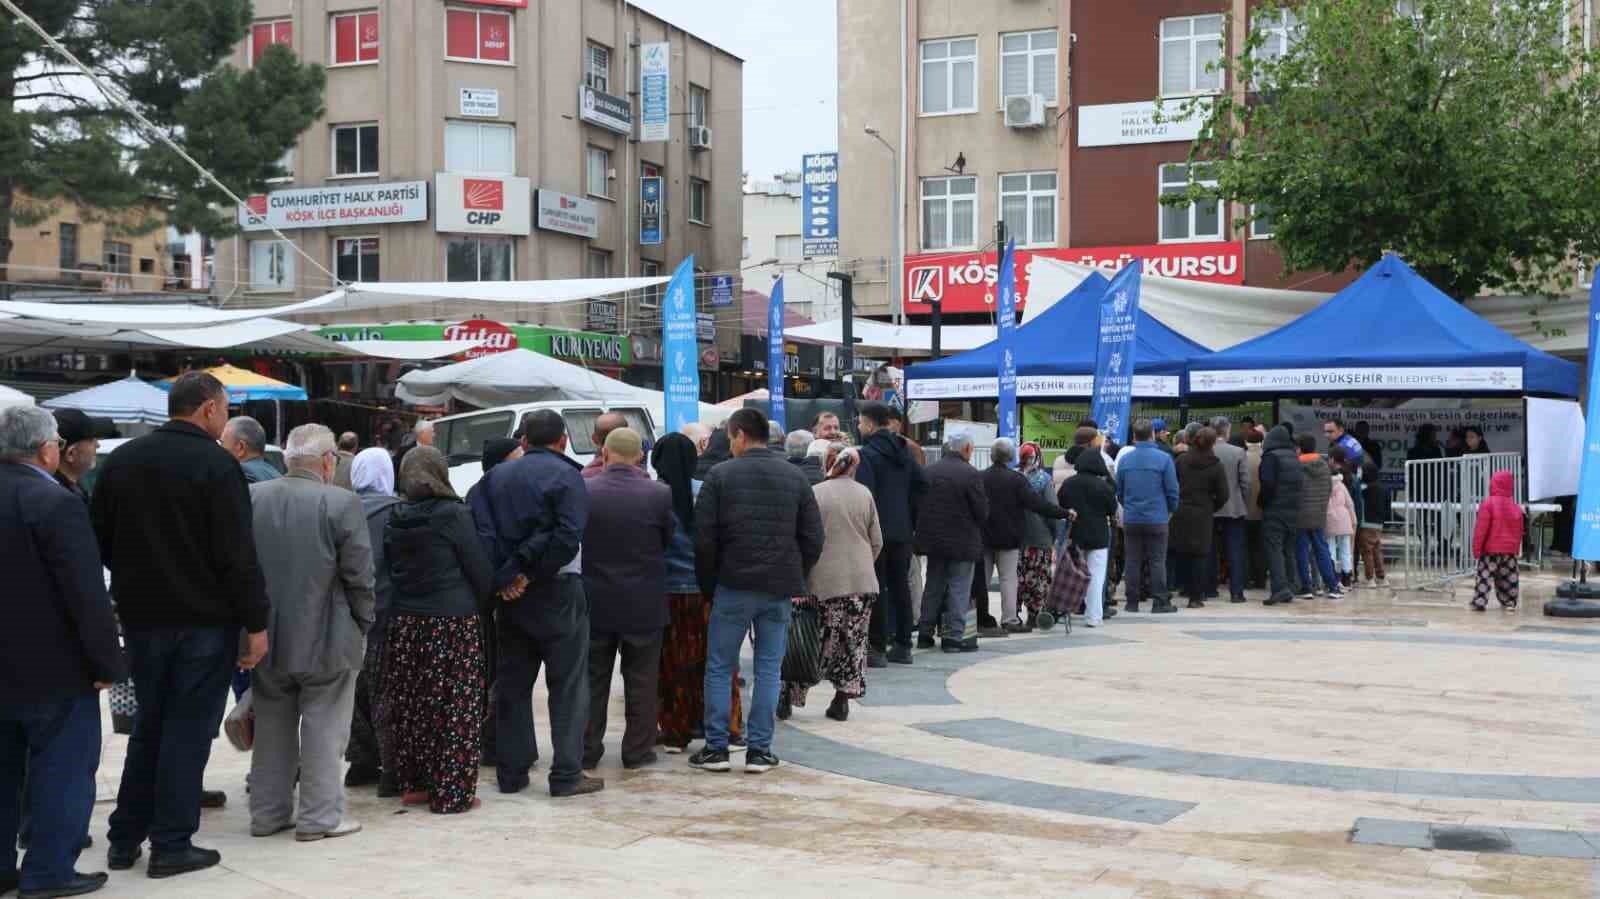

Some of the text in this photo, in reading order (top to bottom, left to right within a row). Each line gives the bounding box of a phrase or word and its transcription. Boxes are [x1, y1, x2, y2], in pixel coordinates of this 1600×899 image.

[1121, 117, 1149, 126] HALK
[271, 184, 420, 209] CUMHURİYET HALK PARTİSİ
[286, 203, 403, 222] KÖŞK İLÇE BAŞKANLIĞI
[466, 211, 500, 225] CHP
[948, 260, 1016, 287] KÖŞ
[1143, 255, 1237, 278] KURSU
[444, 325, 516, 350] Tutar
[1304, 372, 1384, 385] BÜYÜKŞEHİR
[1017, 380, 1065, 393] ÜKŞEHİR
[1314, 409, 1343, 420] Yerel
[1431, 409, 1459, 420] besin
